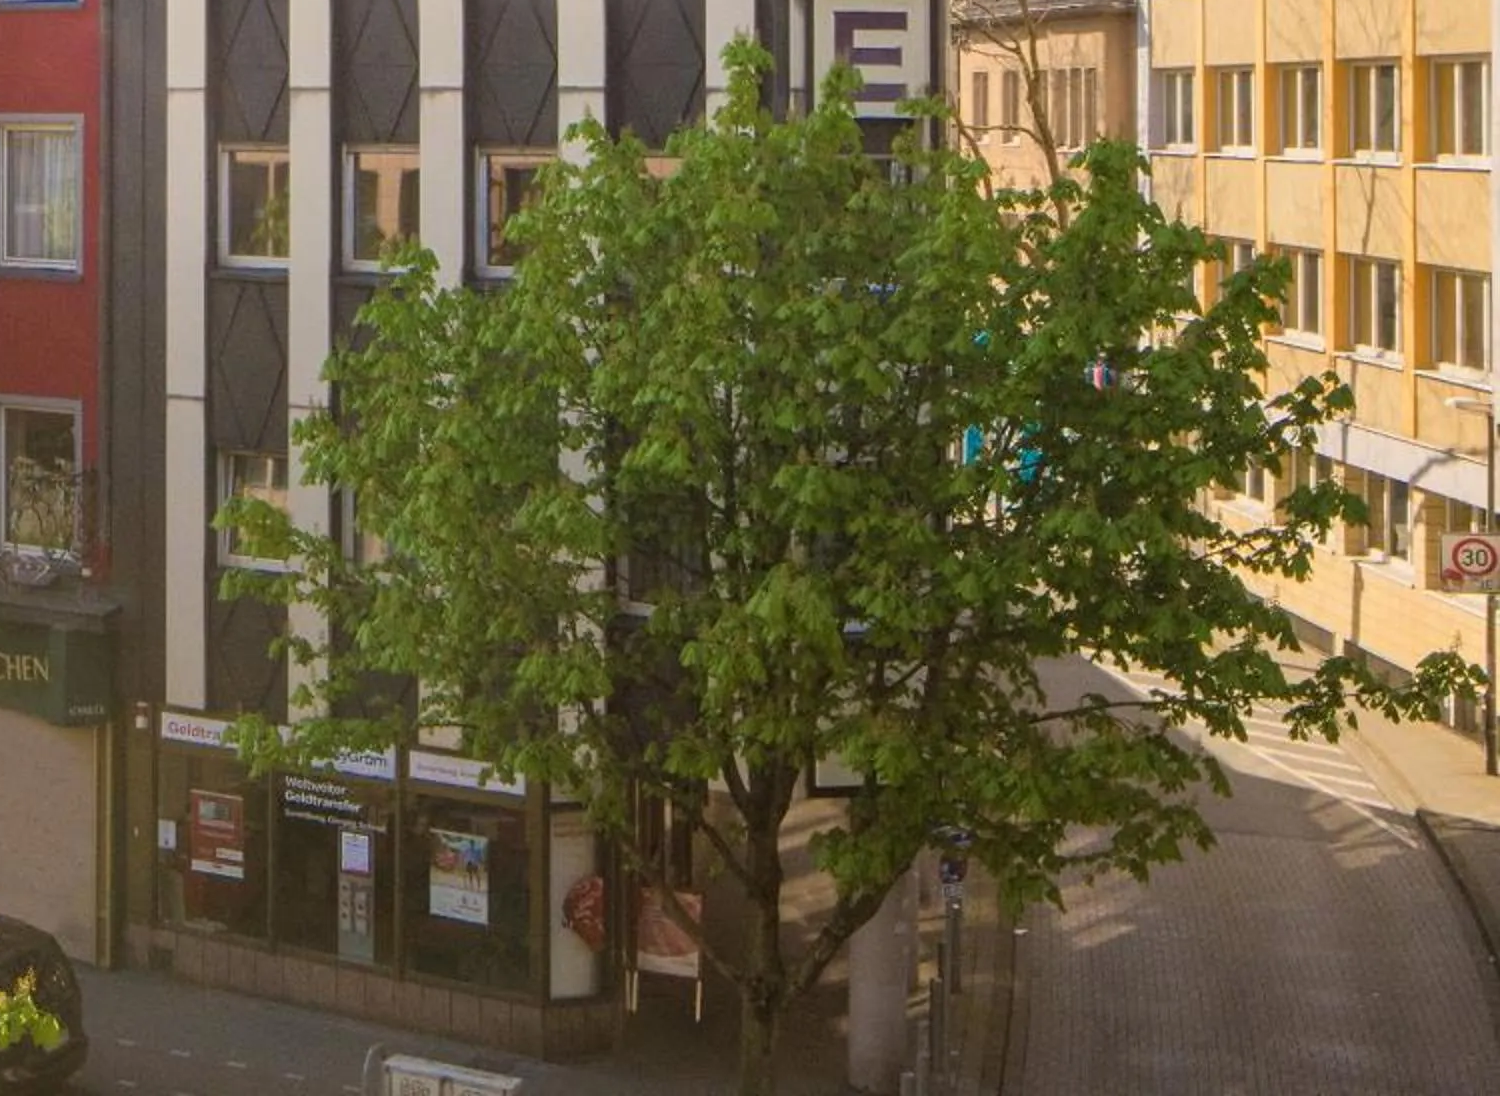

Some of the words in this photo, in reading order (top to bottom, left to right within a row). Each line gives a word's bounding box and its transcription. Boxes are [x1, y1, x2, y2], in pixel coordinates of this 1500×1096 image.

[1462, 549, 1488, 567] 30
[167, 719, 222, 740] Geldtra
[284, 789, 362, 813] Geldtransfer
